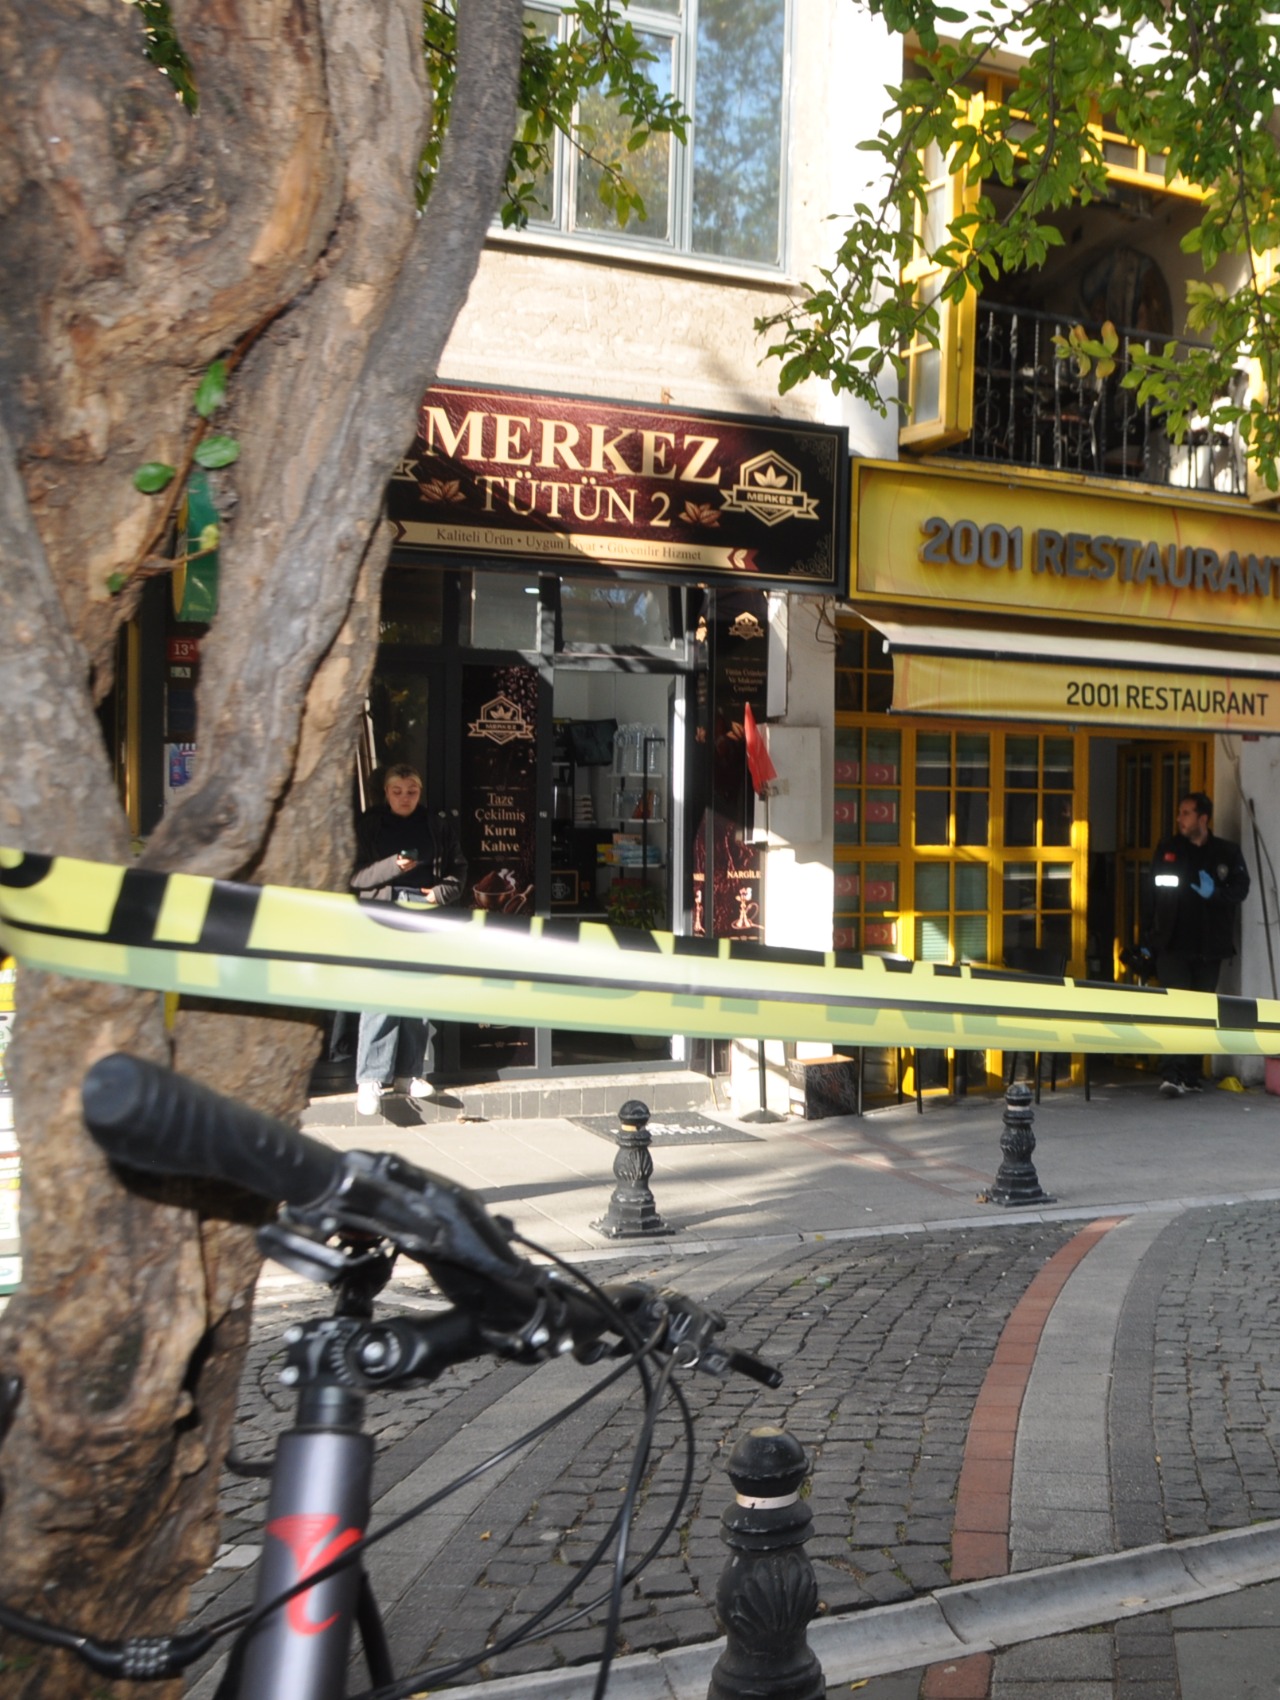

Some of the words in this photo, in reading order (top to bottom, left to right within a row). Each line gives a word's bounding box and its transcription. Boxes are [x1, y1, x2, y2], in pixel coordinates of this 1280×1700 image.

[423, 406, 721, 485] MERKEZ
[475, 471, 638, 525] TÜTÜN
[650, 492, 671, 527] 2
[747, 492, 794, 505] MERKEZ
[436, 529, 481, 544] Kaliteli
[484, 531, 514, 546] Ürün
[526, 535, 564, 551] Uygun
[567, 538, 596, 554] Fiyat
[607, 543, 659, 557] Güvenilir
[662, 546, 702, 561] Hizmet
[920, 516, 1023, 571] 2001
[1066, 681, 1119, 708] 2001
[1126, 685, 1269, 716] RESTAURANT
[487, 793, 514, 805] Taze
[474, 808, 526, 822] Çekilmiş
[484, 824, 516, 837] Kuru
[481, 840, 520, 852] Kahve
[727, 870, 761, 879] NARGİLE
